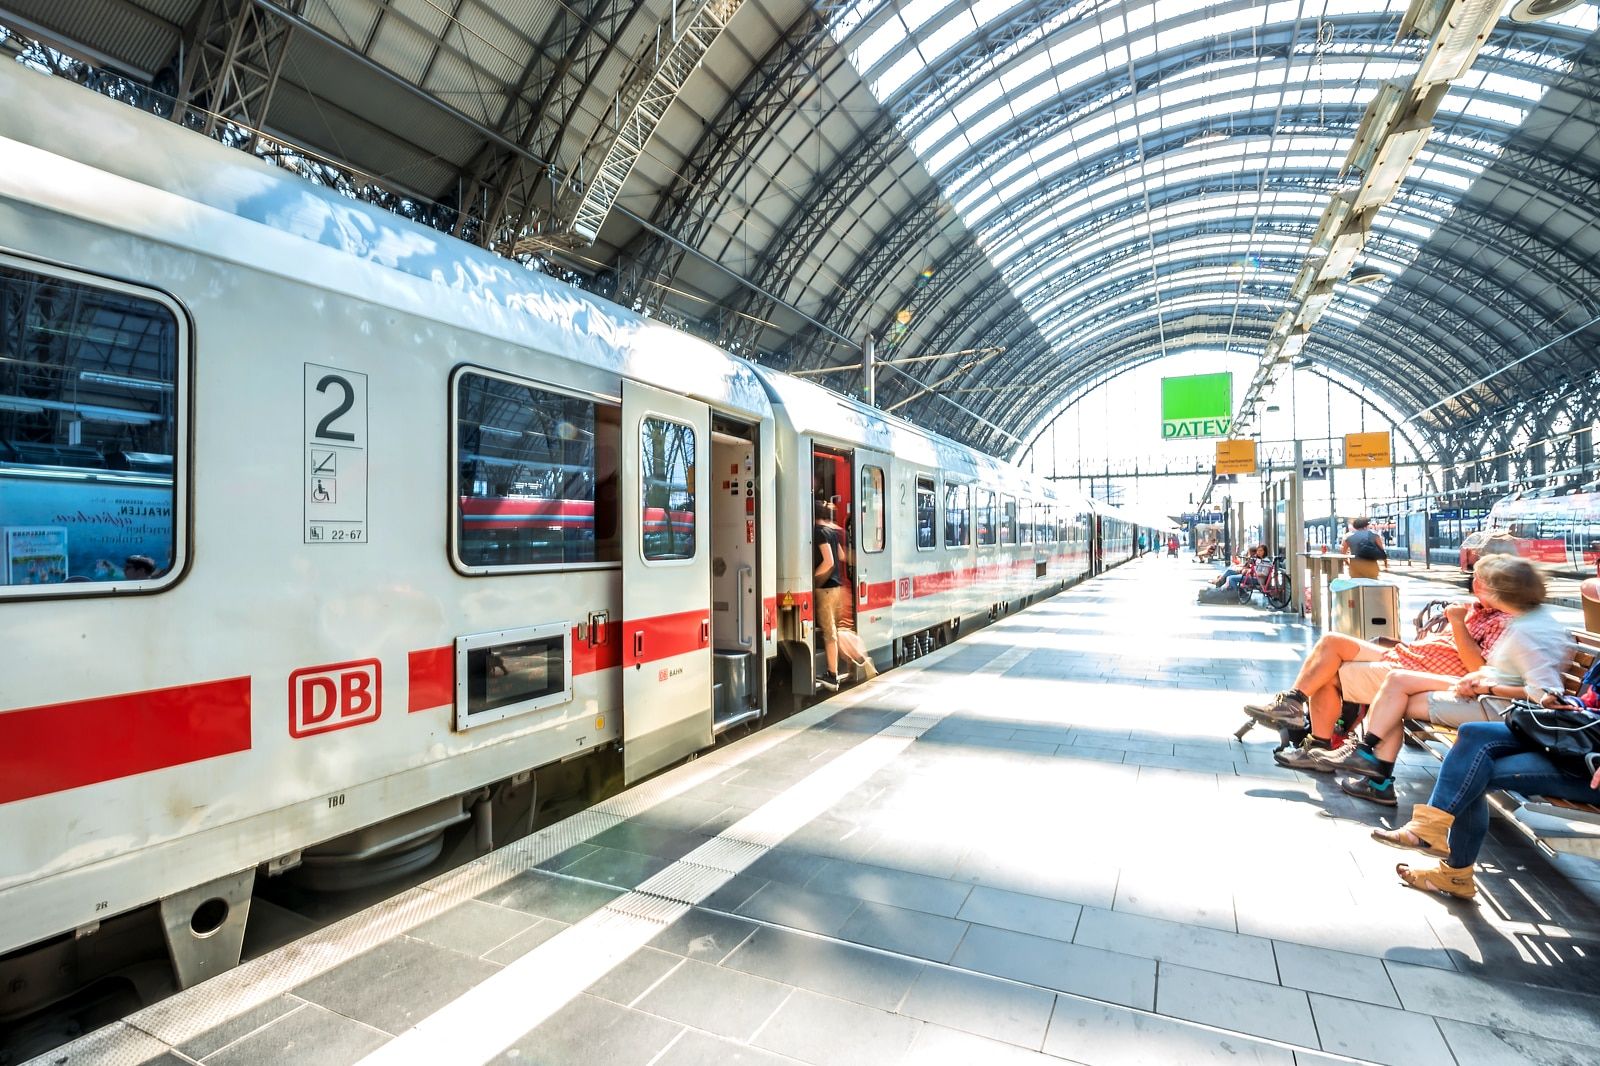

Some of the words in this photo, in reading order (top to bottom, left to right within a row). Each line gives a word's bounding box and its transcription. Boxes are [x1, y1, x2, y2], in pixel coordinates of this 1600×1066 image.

[315, 374, 355, 441] 2
[1163, 419, 1231, 437] DATEV
[1308, 459, 1324, 477] A
[900, 483, 906, 506] 2
[331, 529, 362, 540] 22-67
[900, 580, 909, 598] DB
[669, 667, 683, 677] BAHN
[302, 670, 372, 726] DB
